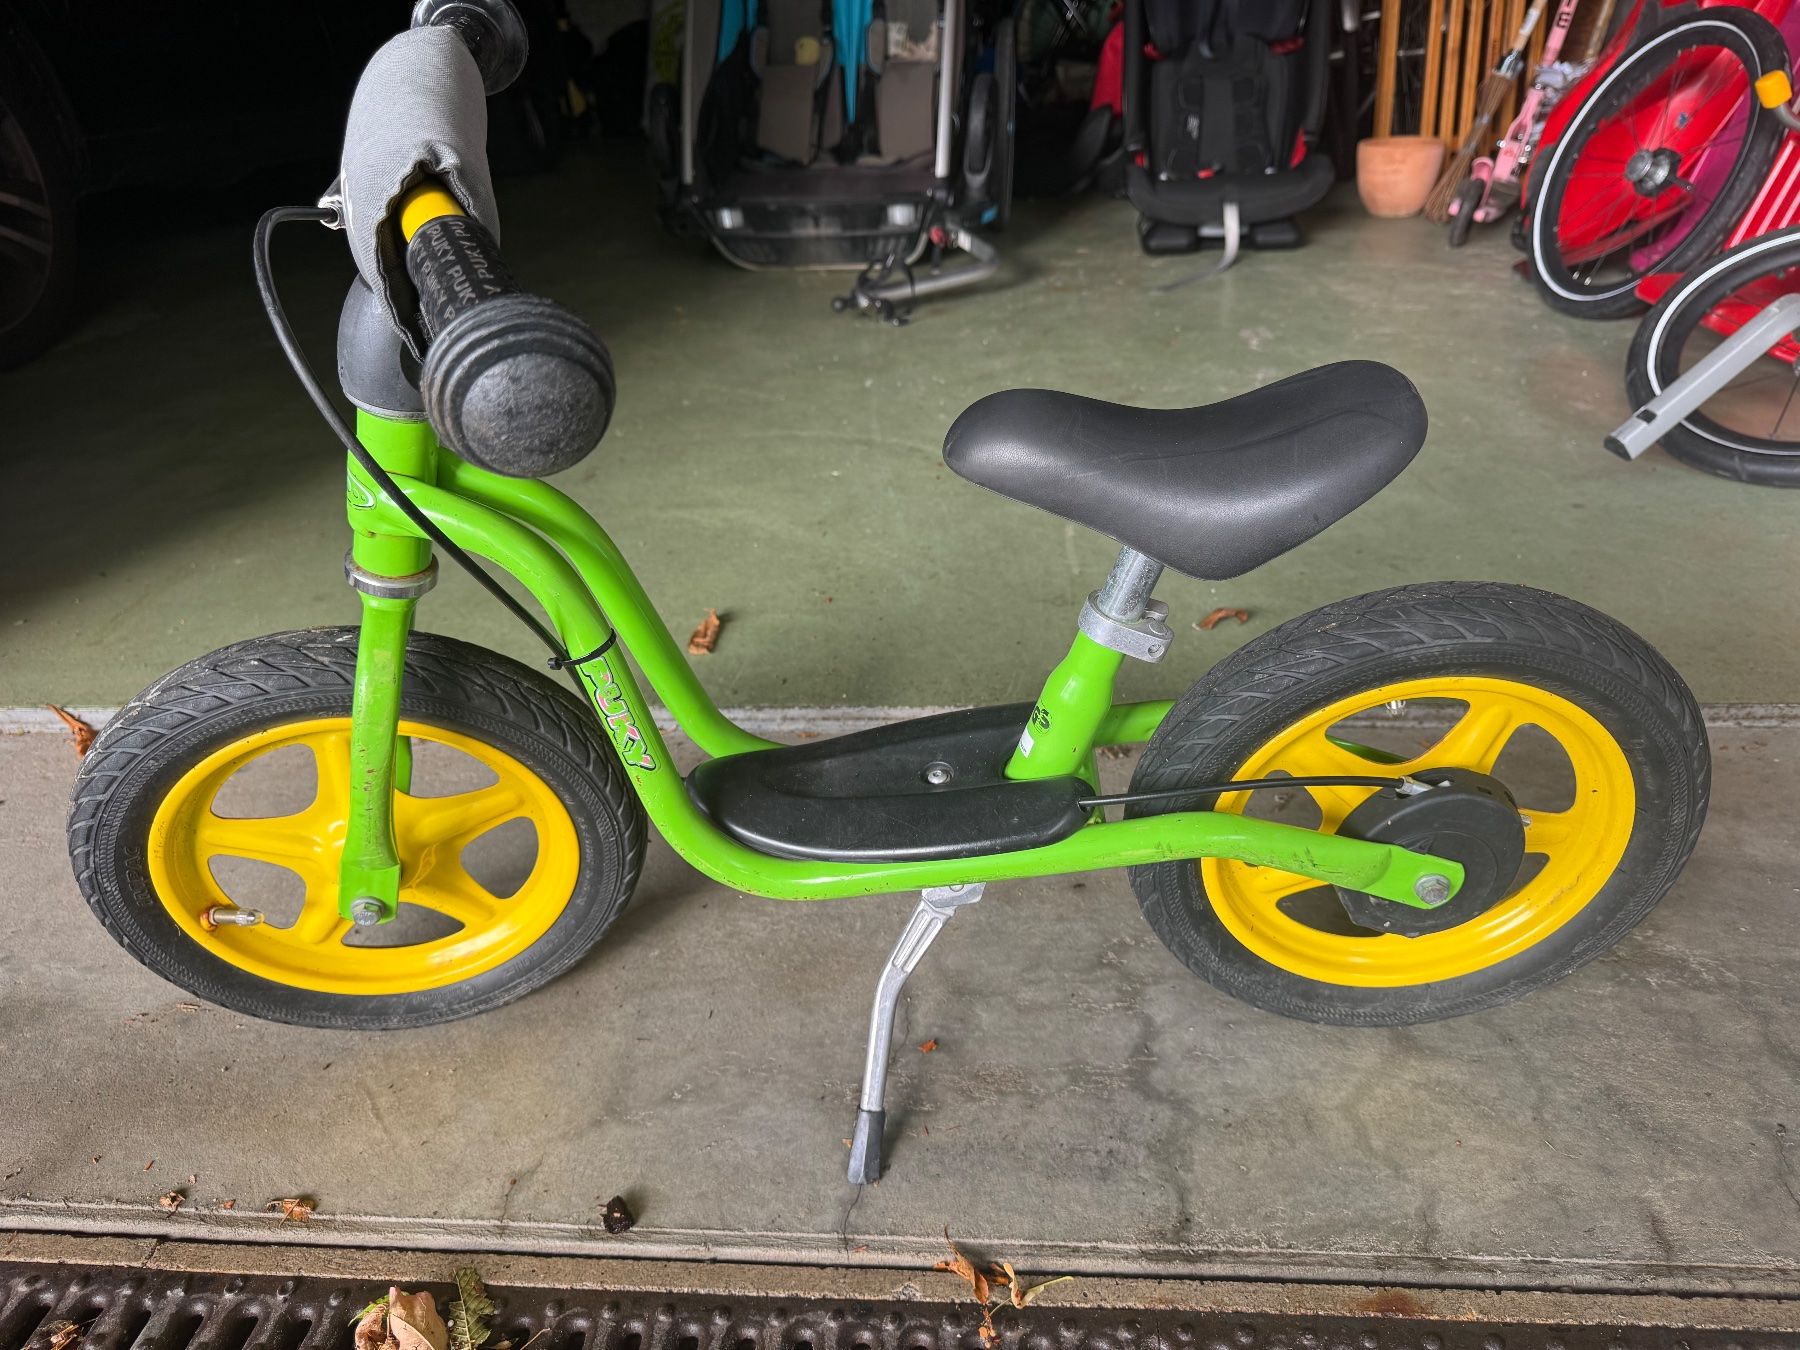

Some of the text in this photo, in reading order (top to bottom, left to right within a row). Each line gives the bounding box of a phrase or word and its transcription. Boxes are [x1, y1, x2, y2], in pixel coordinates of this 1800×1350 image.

[425, 223, 479, 305] PUKY PUK
[579, 655, 657, 772] PUKY
